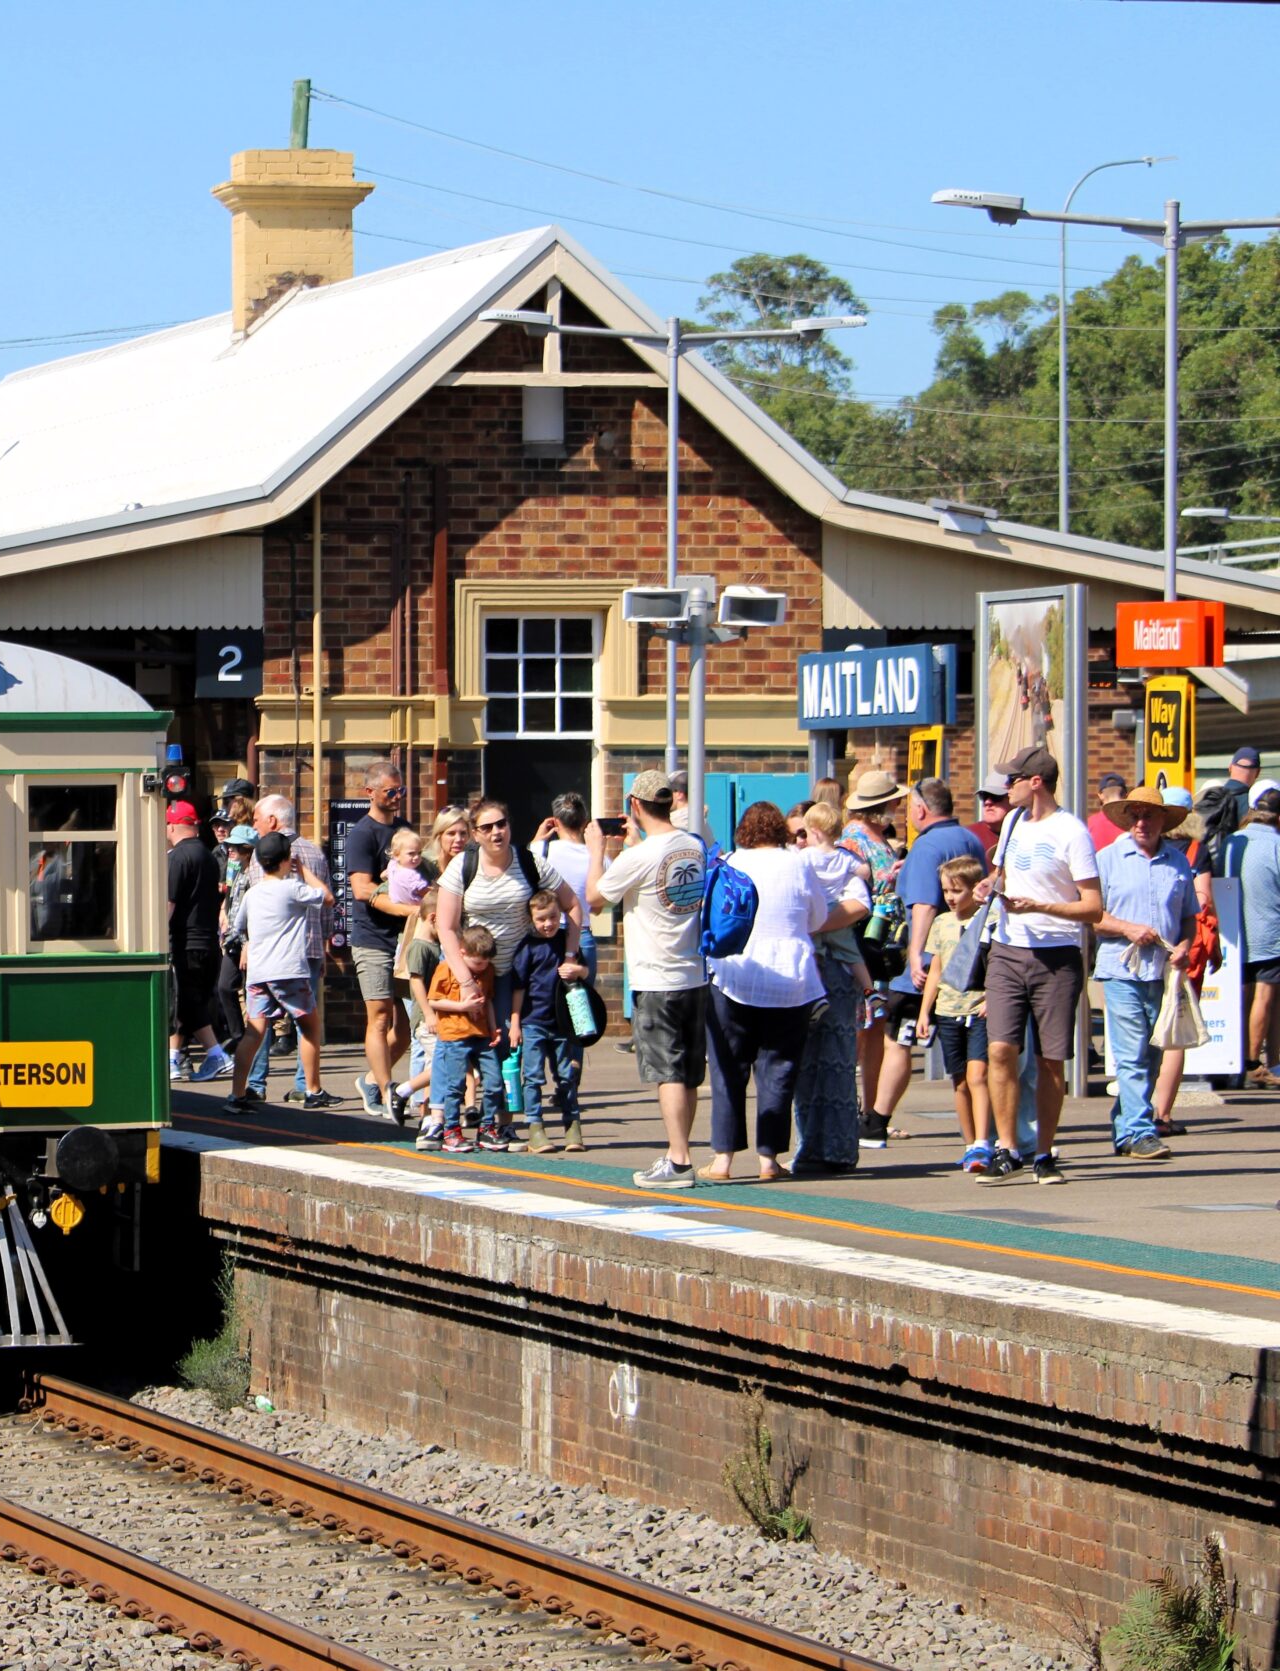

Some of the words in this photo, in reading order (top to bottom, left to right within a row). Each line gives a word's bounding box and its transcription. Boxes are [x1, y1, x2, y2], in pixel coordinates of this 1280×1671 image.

[1133, 619, 1180, 650] Maitland
[218, 645, 242, 681] 2
[803, 657, 919, 718] MAITLAND
[1150, 697, 1176, 731] Way
[1152, 731, 1174, 757] Out
